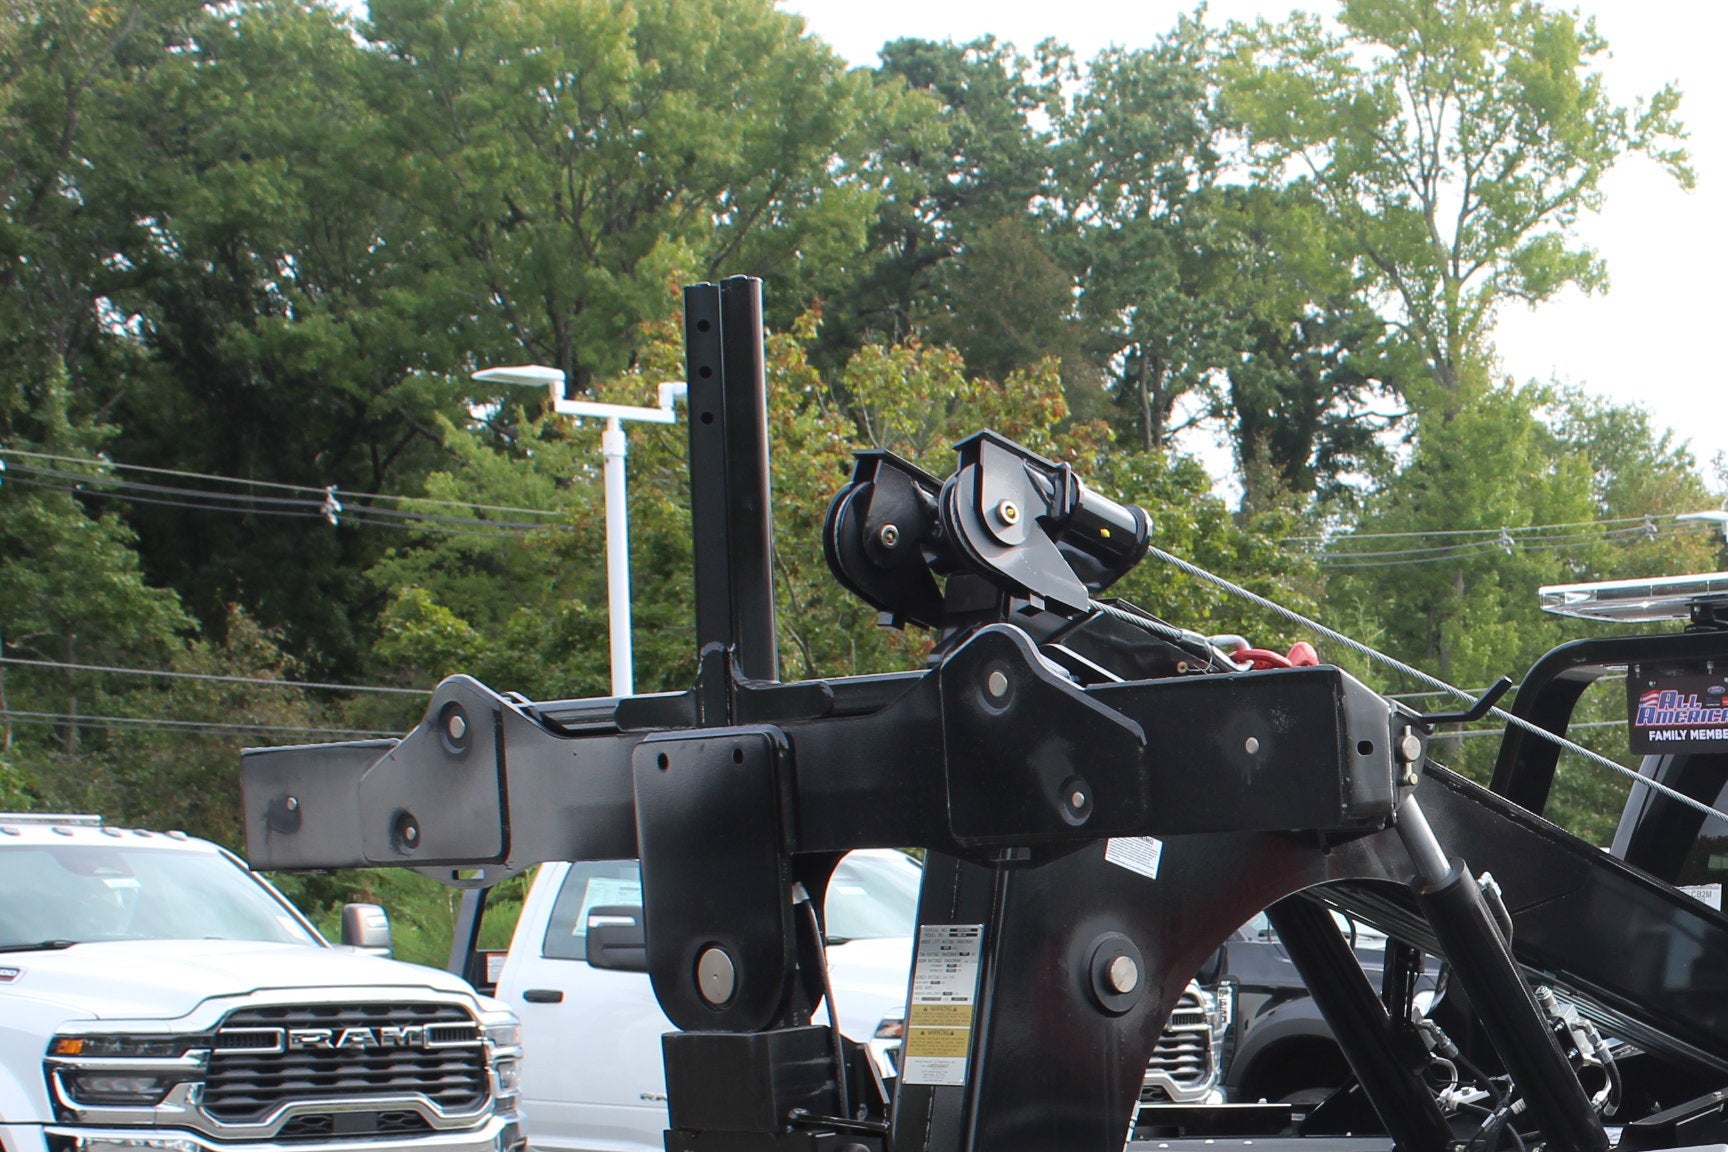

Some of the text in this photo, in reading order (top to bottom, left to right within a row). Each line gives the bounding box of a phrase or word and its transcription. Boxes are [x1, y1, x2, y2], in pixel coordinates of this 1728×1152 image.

[1658, 689, 1702, 710] ALL
[1649, 729, 1687, 742] FAMILY
[288, 1026, 423, 1050] RAM
[640, 1093, 668, 1102] RA
